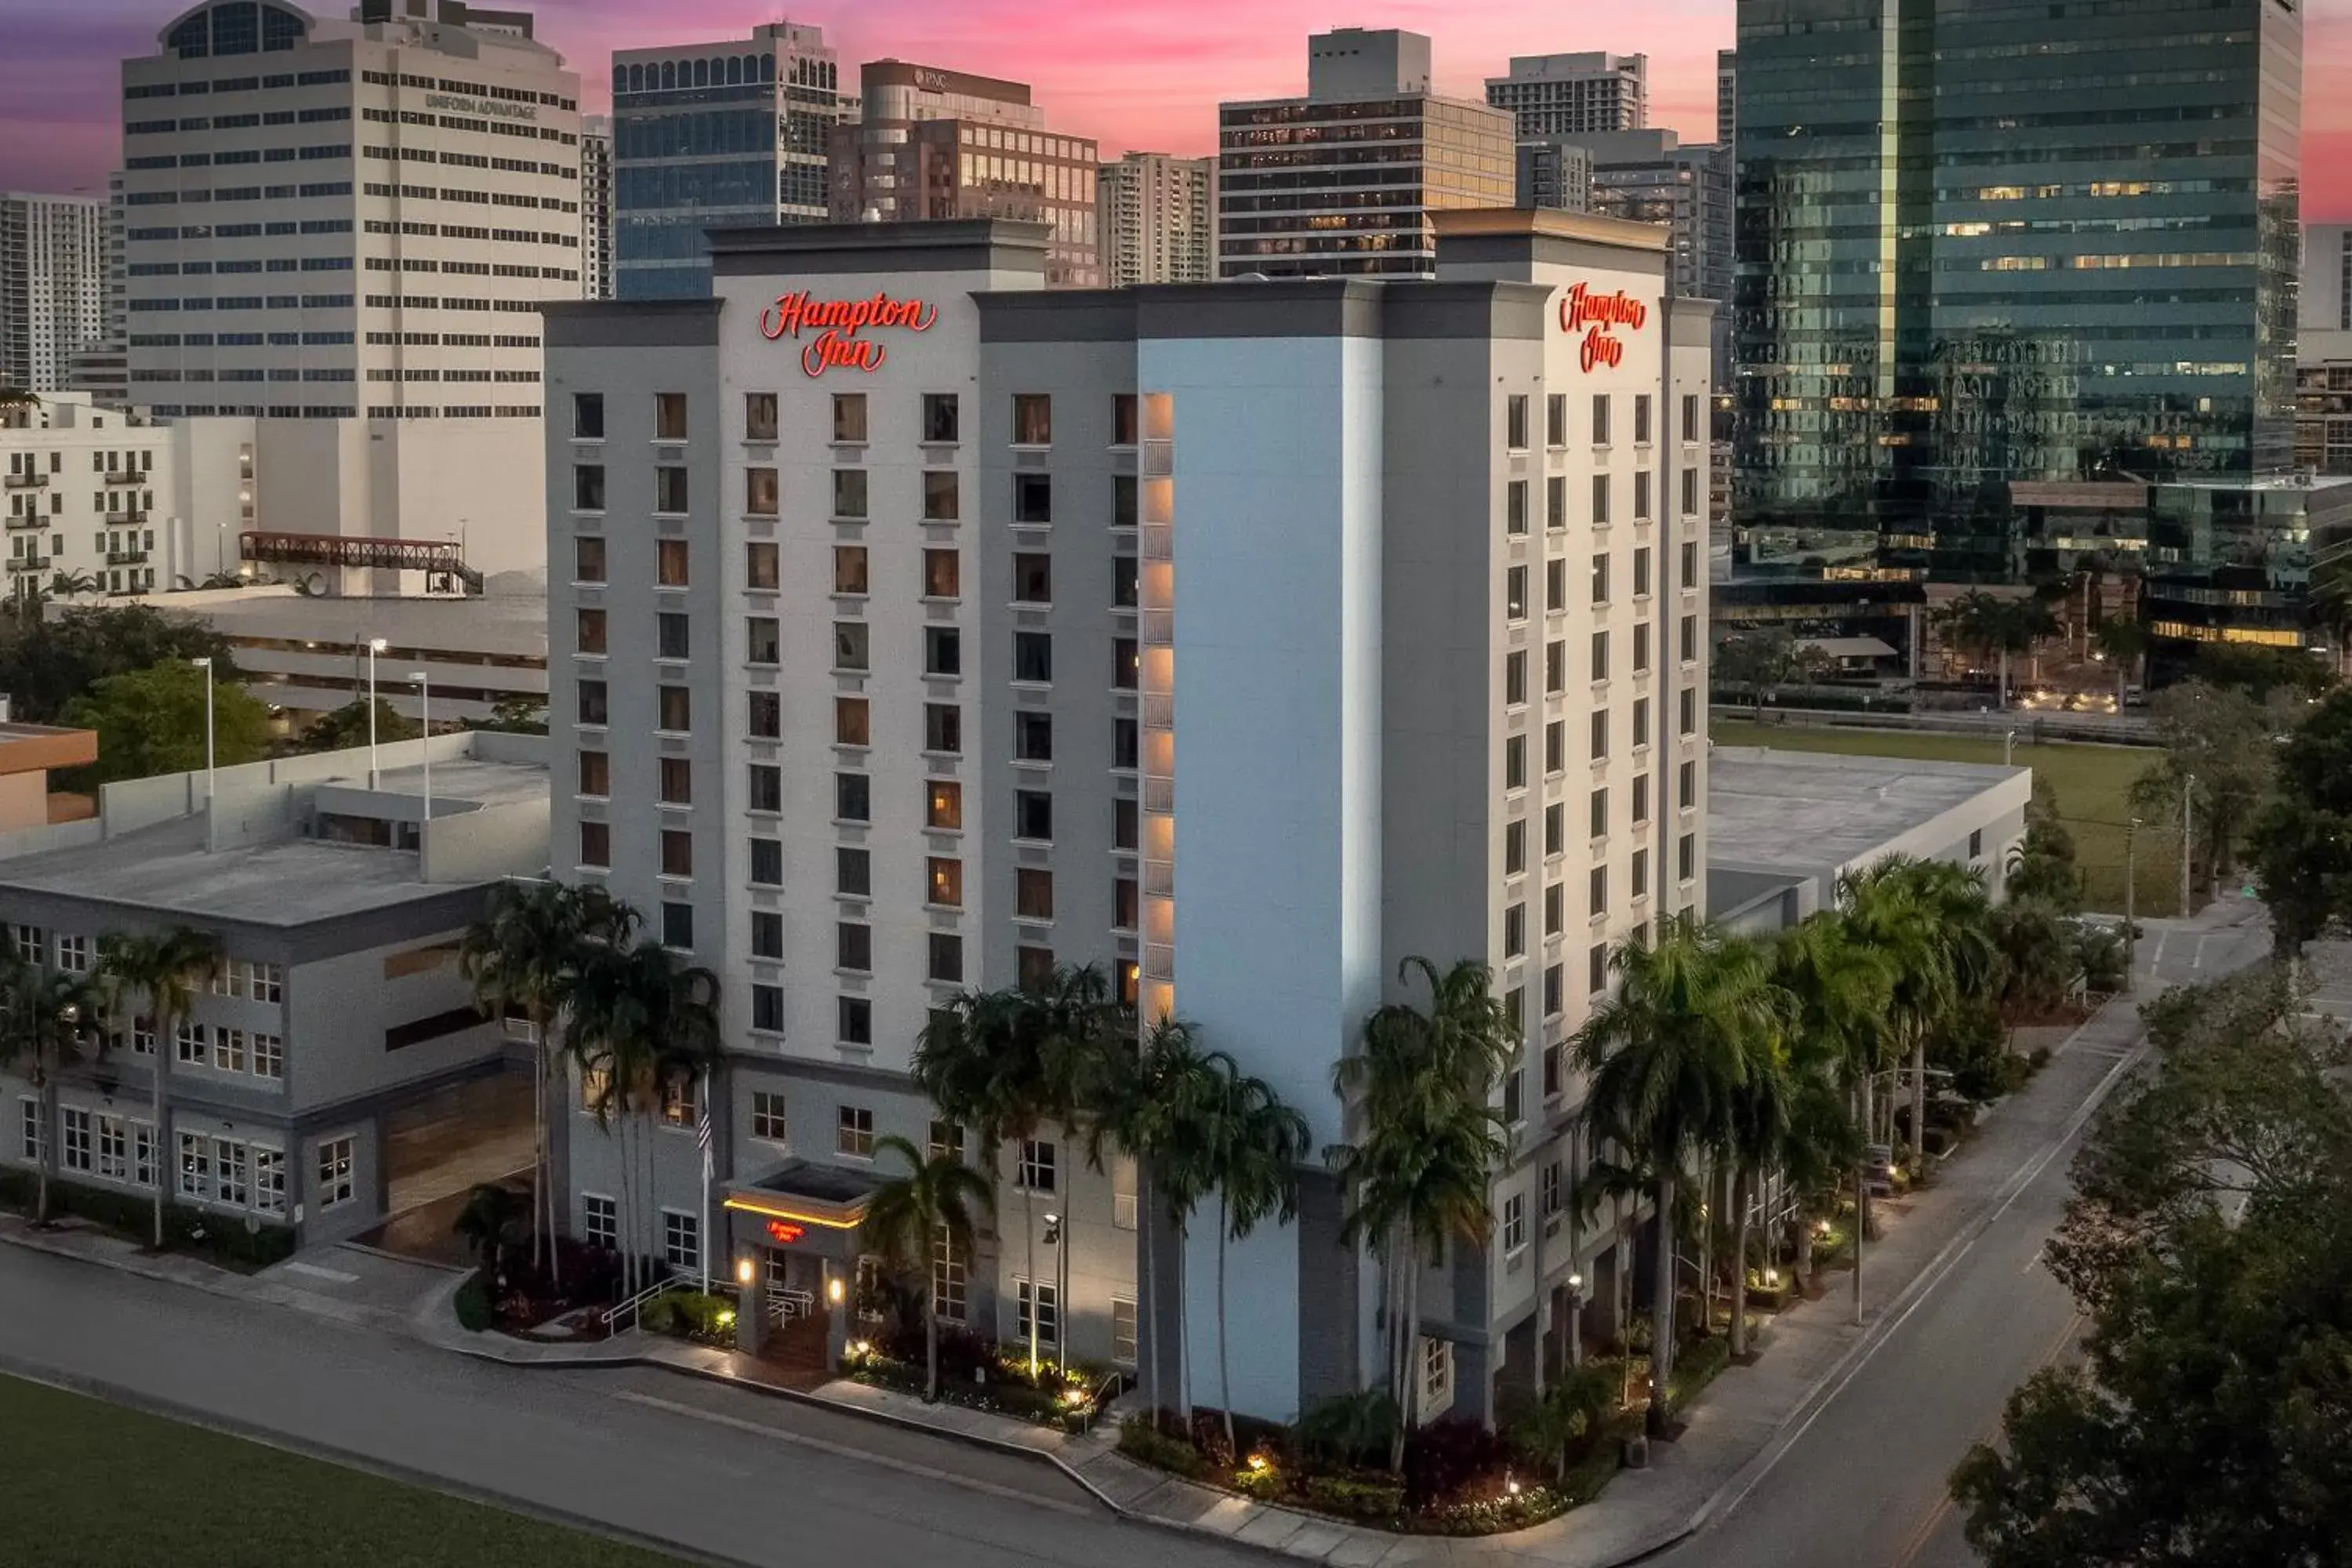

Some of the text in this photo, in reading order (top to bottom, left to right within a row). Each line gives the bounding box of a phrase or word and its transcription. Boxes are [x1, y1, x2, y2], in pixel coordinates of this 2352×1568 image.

[926, 71, 947, 88] PNC
[426, 94, 537, 120] UNIFORM ADVANTAGE
[760, 289, 938, 339] Hampton
[1559, 281, 1646, 333] Hampton
[802, 329, 886, 377] Inn
[1581, 325, 1623, 373] Inn
